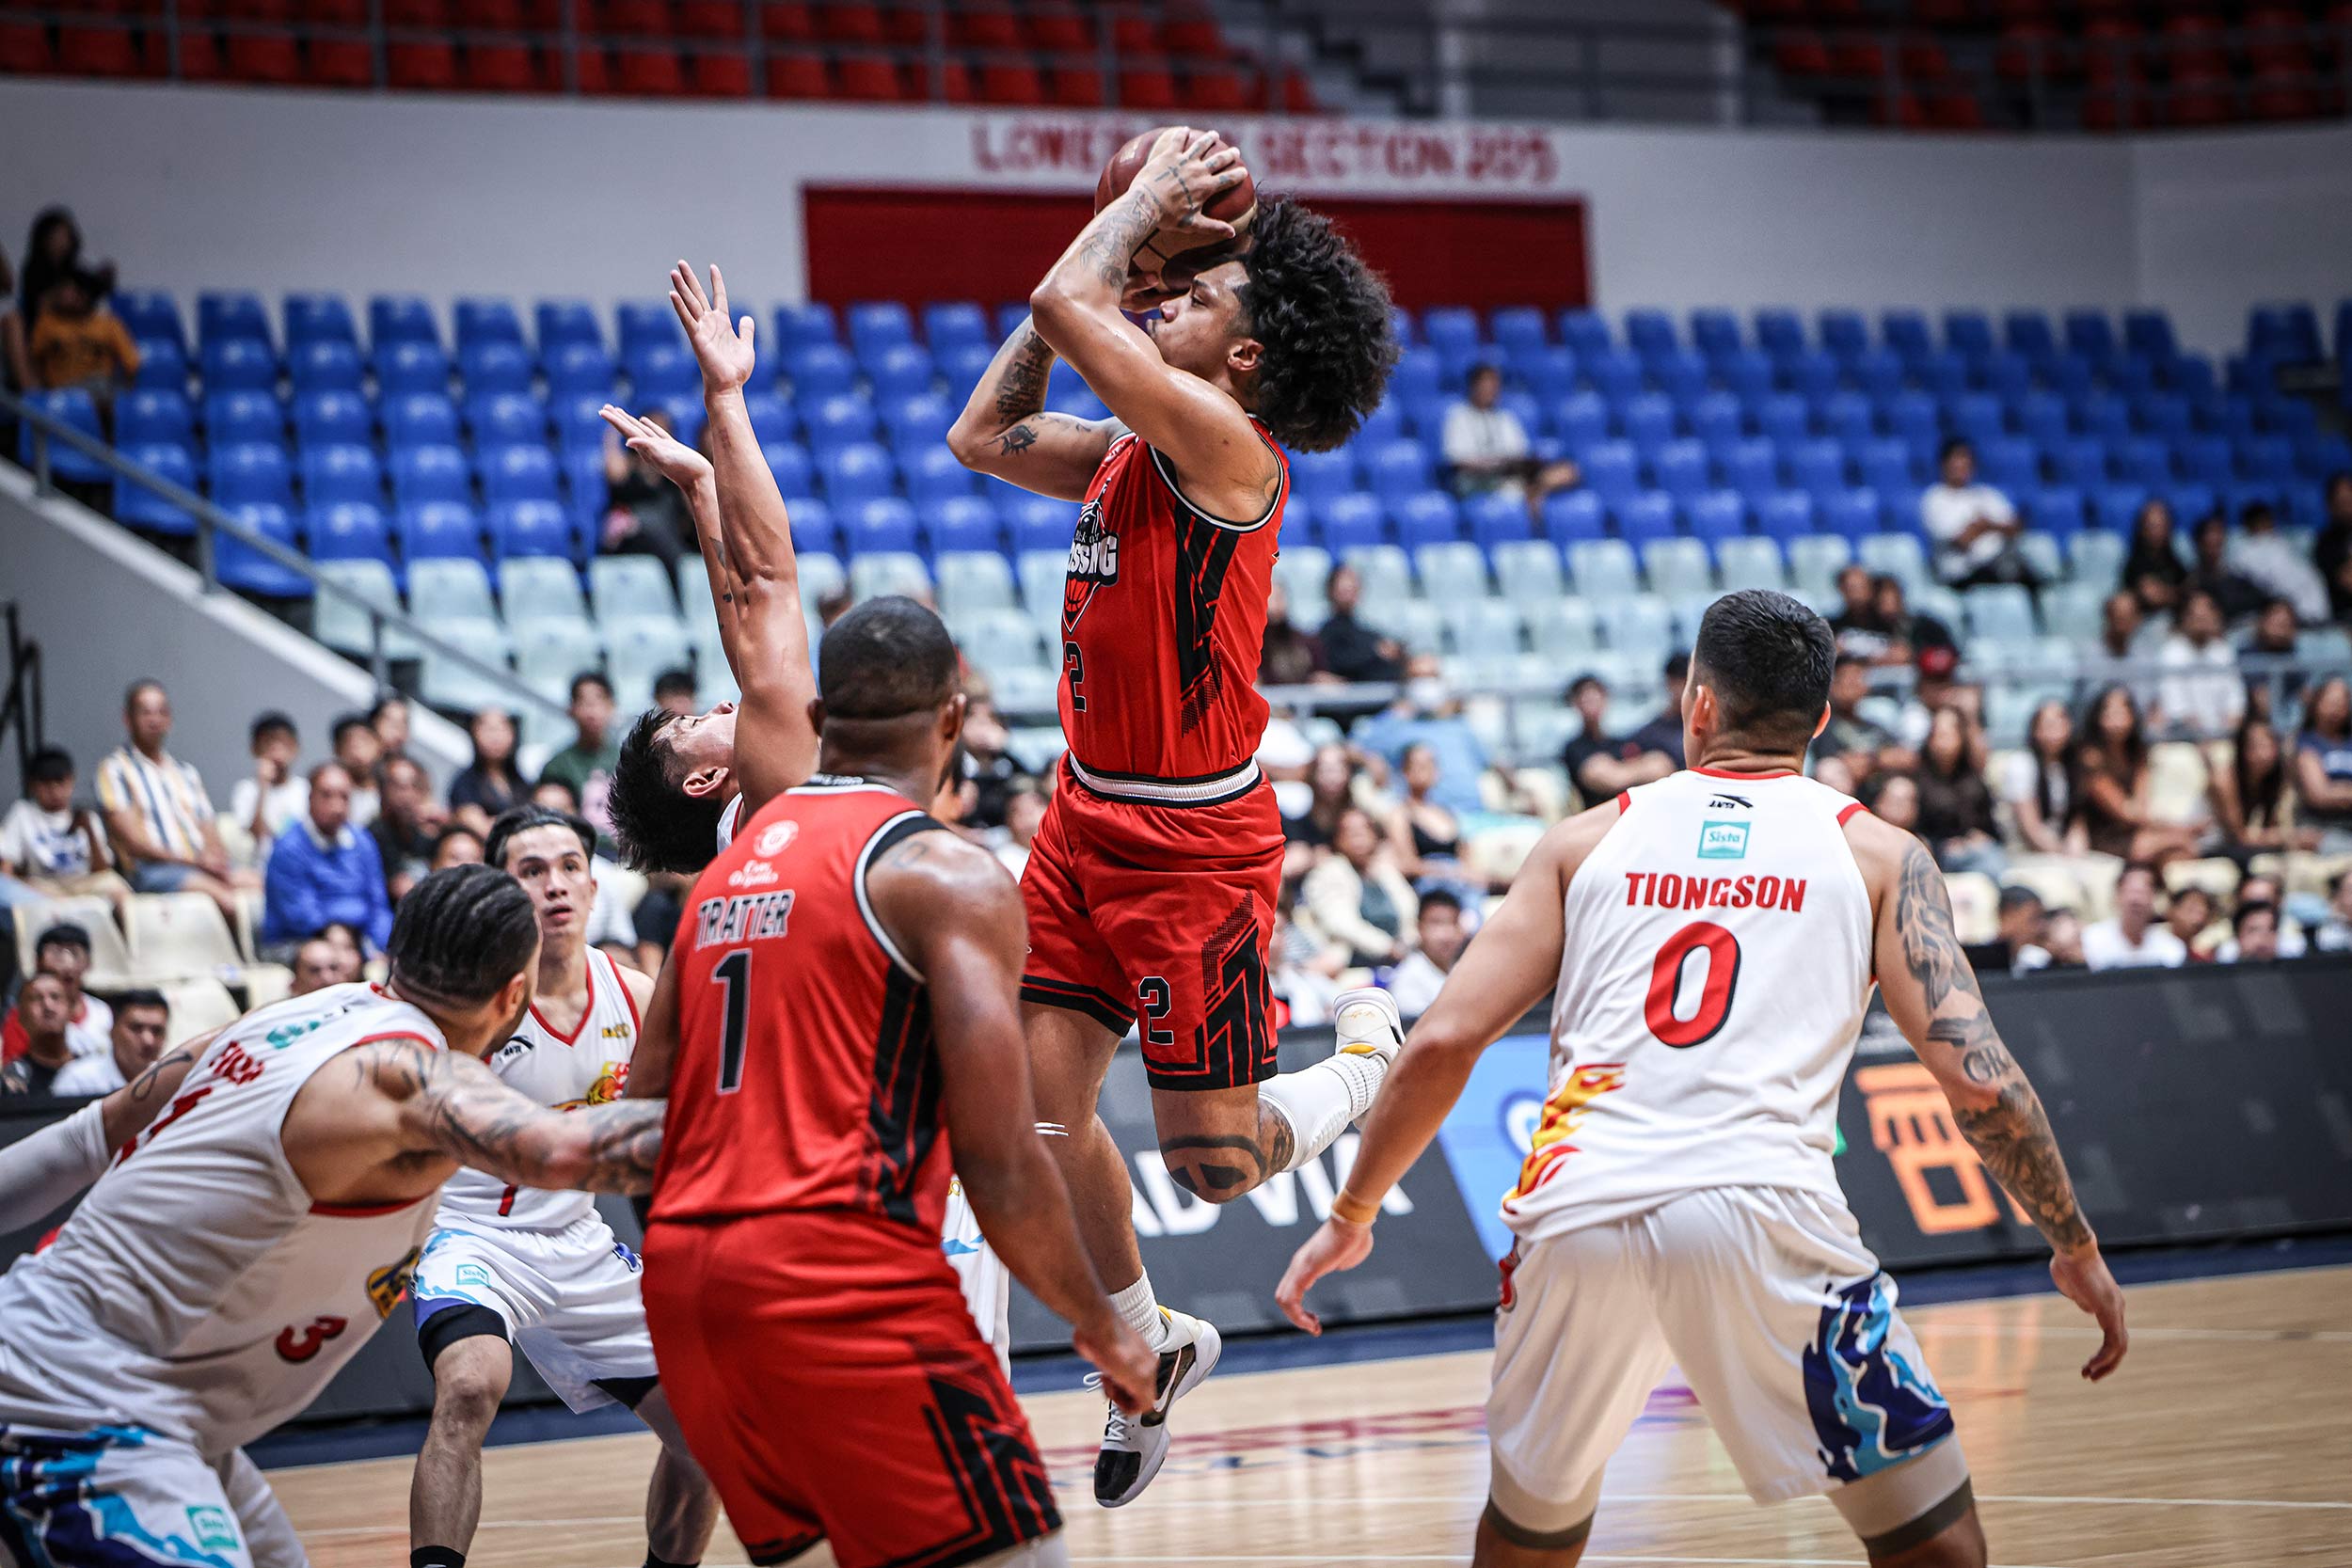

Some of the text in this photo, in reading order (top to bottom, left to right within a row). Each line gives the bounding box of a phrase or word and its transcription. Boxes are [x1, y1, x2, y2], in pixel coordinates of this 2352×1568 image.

[1258, 123, 1454, 179] SECTION
[1064, 641, 1087, 712] 2
[694, 889, 796, 952] TRATTER
[1625, 872, 1807, 912] TIONGSON
[1138, 975, 1174, 1046] 2
[1644, 921, 1741, 1049] 0
[710, 948, 753, 1096] 1
